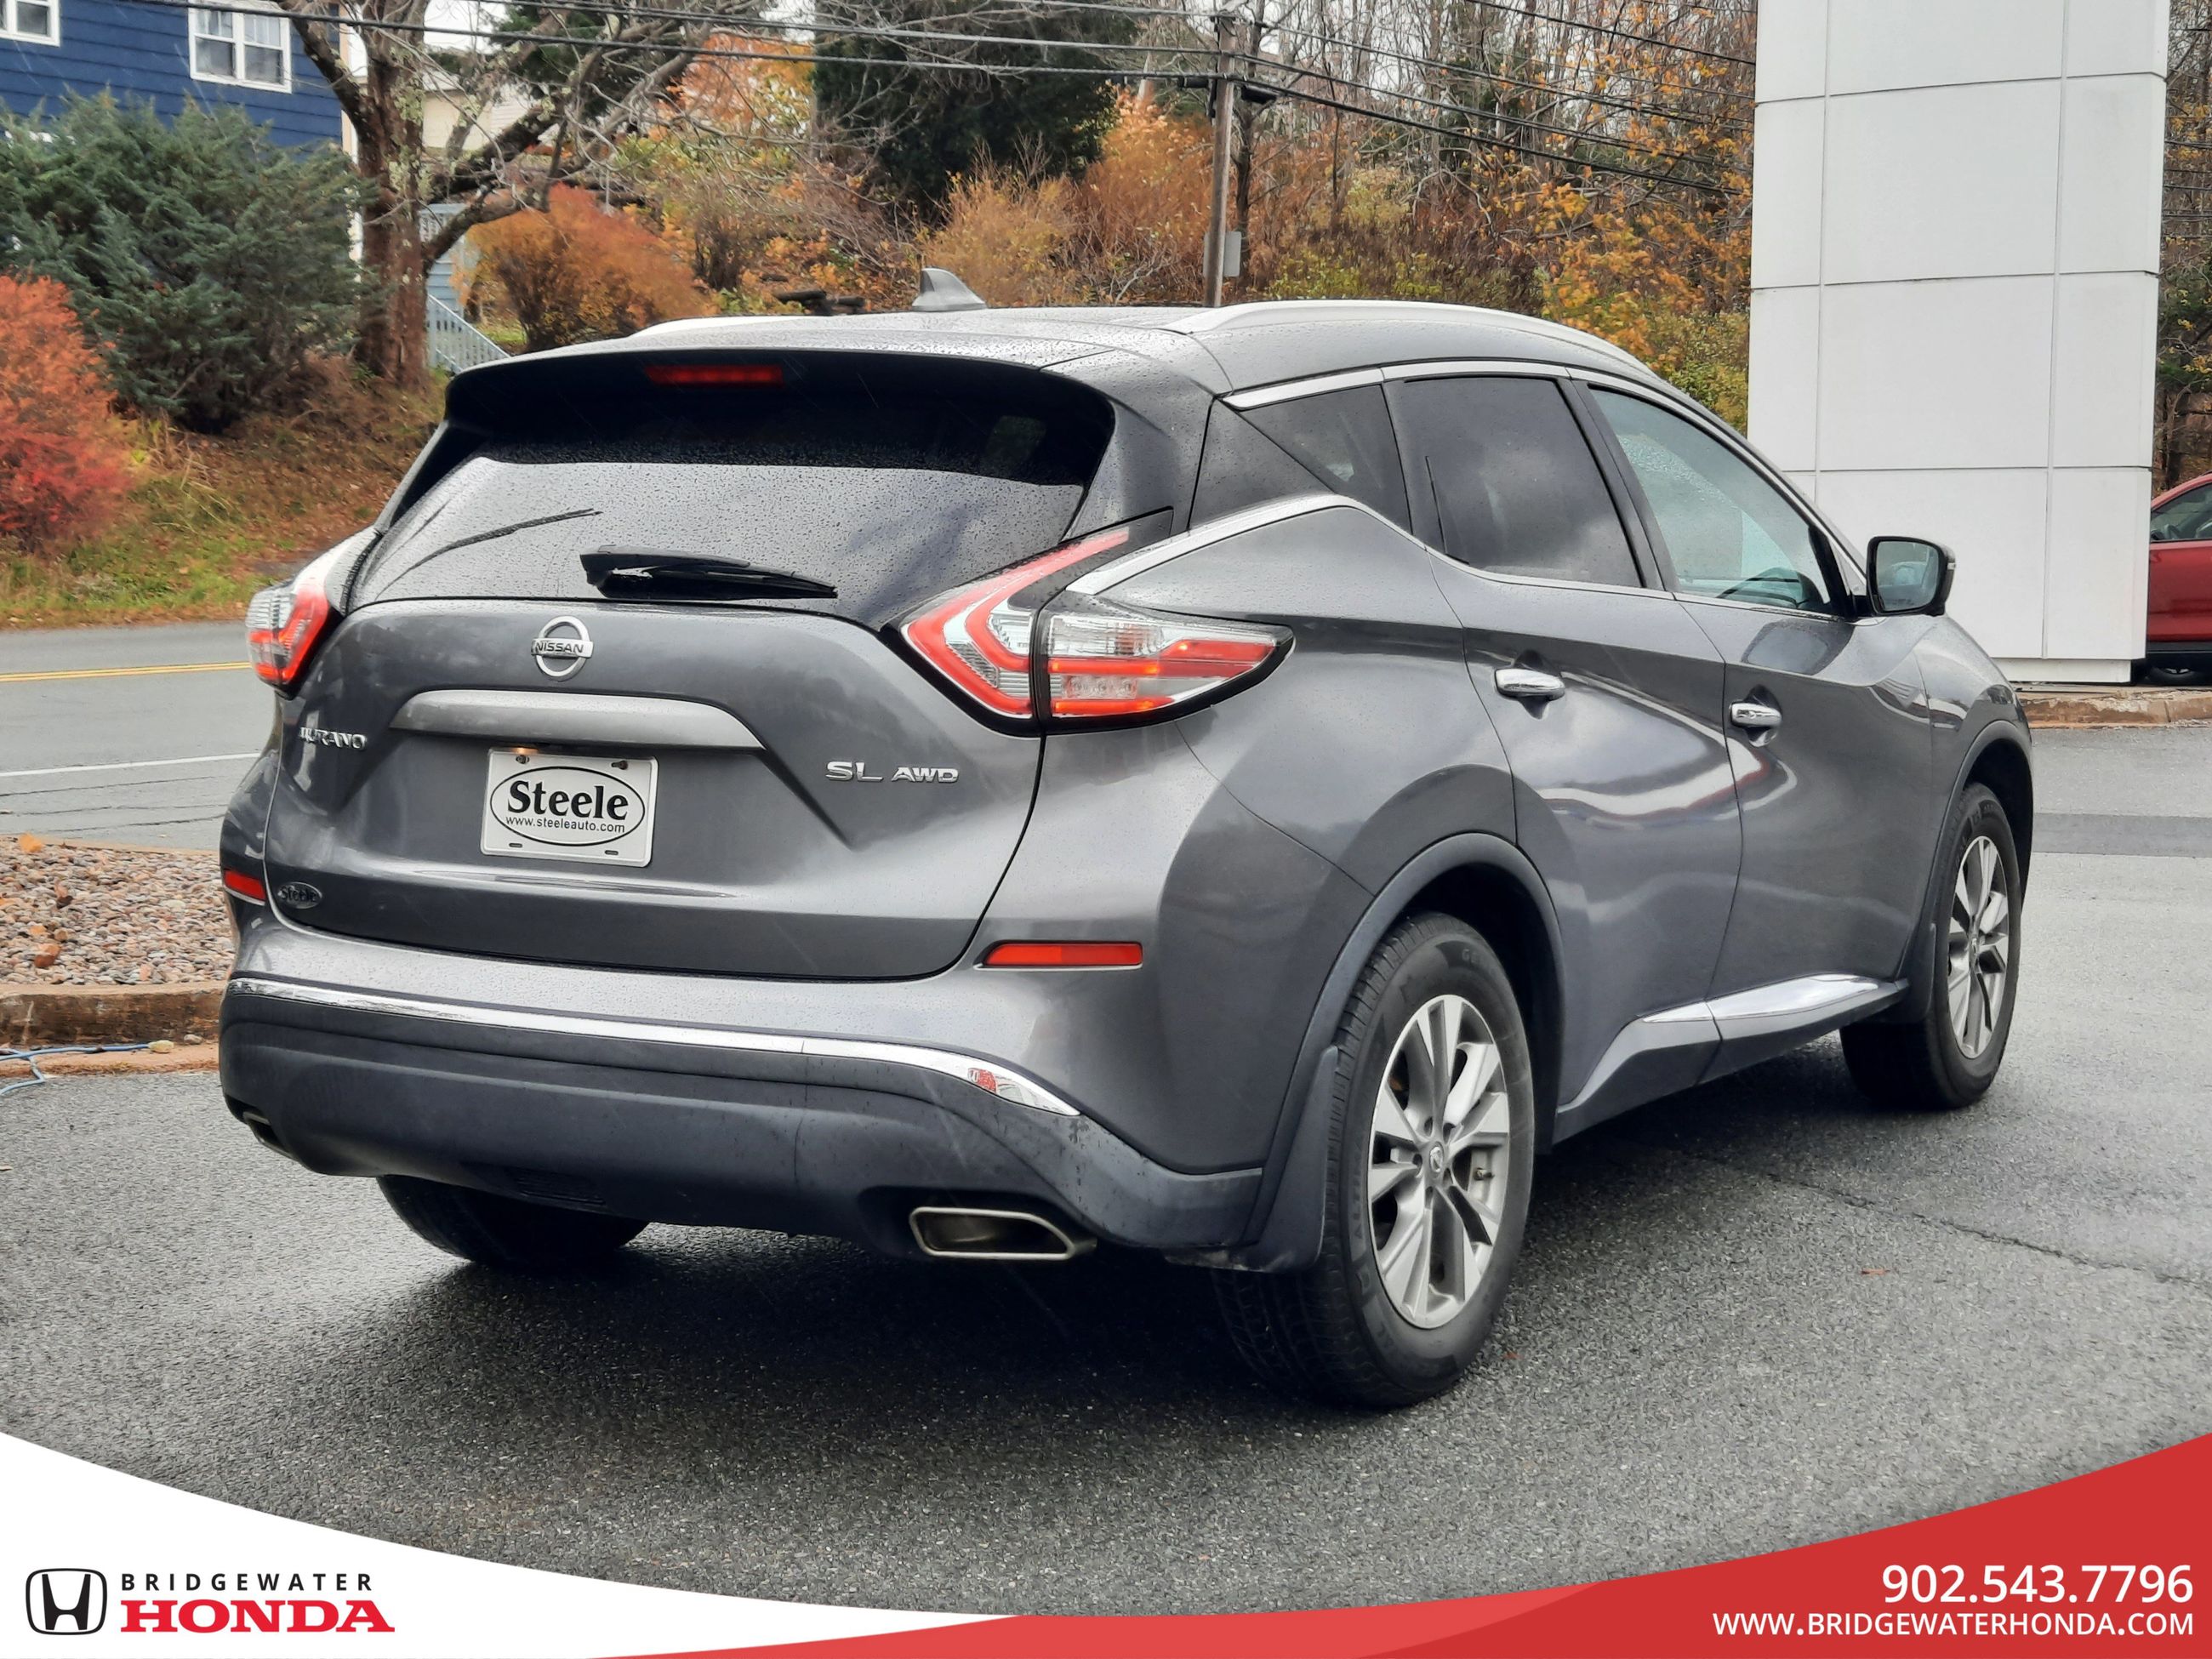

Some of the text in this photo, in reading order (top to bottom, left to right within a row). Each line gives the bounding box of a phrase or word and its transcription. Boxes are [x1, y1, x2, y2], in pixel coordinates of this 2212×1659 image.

[535, 641, 584, 654] NISSAN
[825, 761, 960, 784] SL AWD
[507, 780, 629, 820] Steele
[505, 814, 625, 833] www.steeleauto.com
